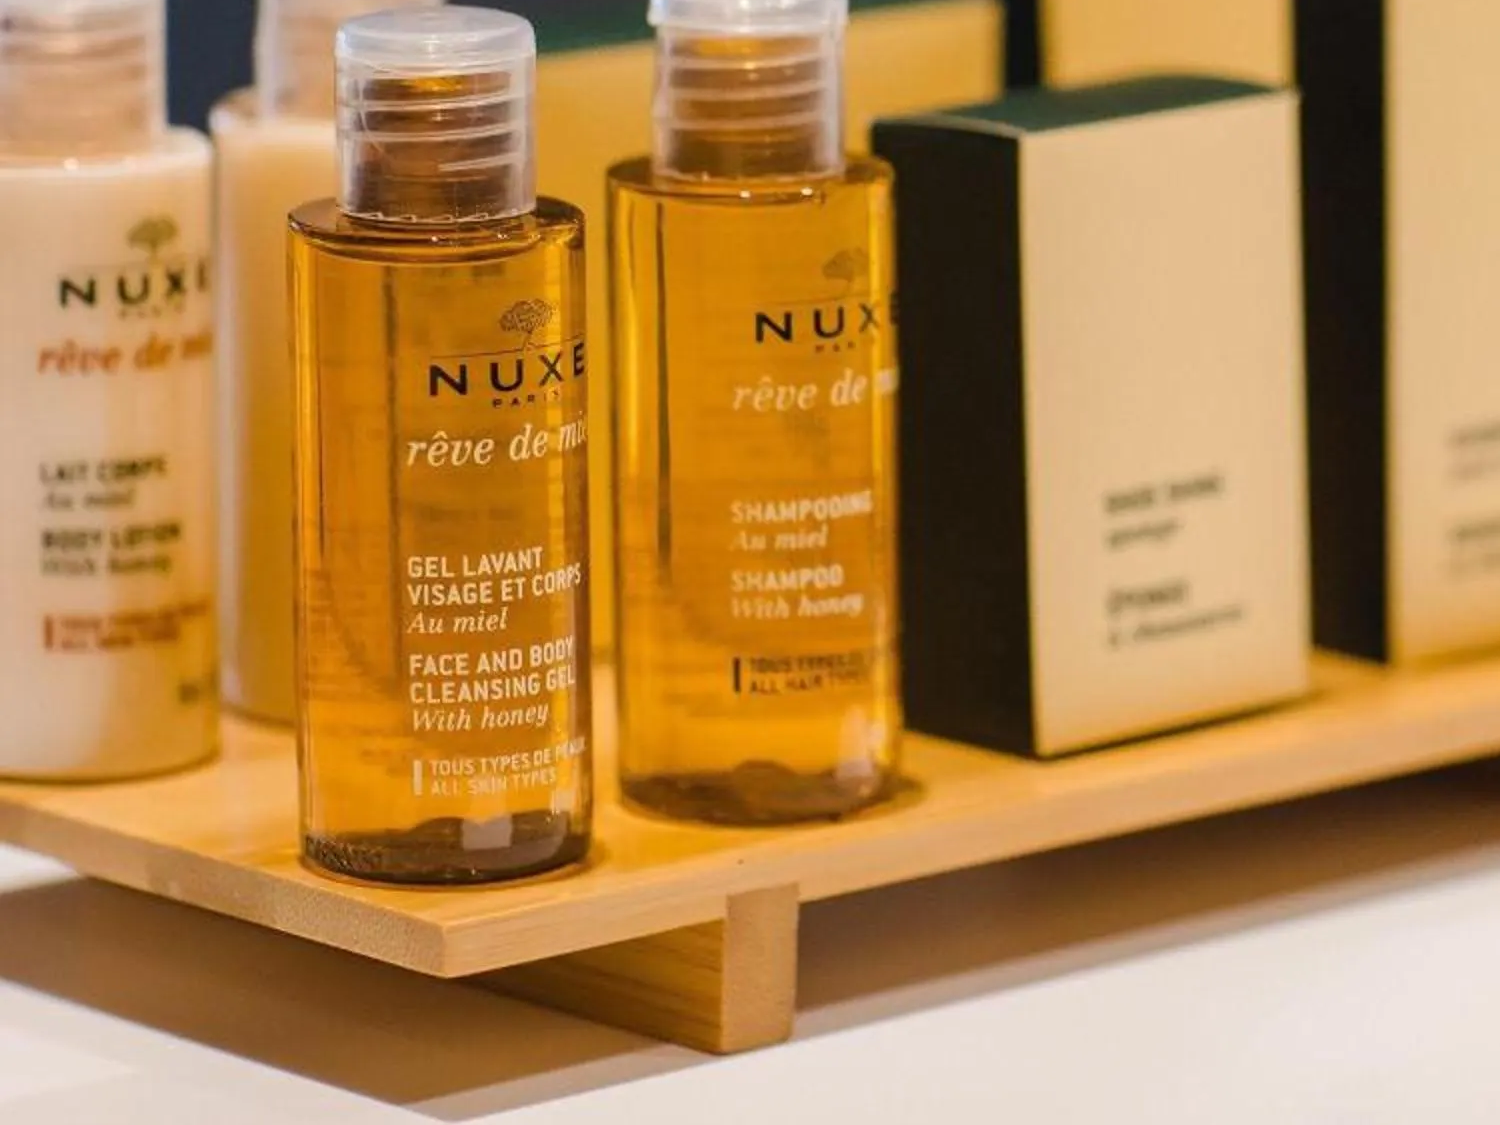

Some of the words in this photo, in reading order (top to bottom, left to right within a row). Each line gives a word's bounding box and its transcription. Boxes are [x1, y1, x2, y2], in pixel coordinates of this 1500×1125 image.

[732, 374, 817, 412] rêve
[831, 367, 868, 407] de
[406, 430, 495, 467] rêve
[509, 422, 549, 461] de
[775, 523, 828, 550] miel
[407, 555, 454, 578] GEL
[463, 546, 543, 576] LAVANT
[731, 563, 844, 592] SHAMPOO
[407, 580, 493, 606] VISAGE
[501, 576, 526, 602] ET
[531, 562, 581, 597] CORPS
[406, 611, 443, 634] Au
[453, 606, 509, 633] miel
[409, 653, 469, 676] FACE
[476, 648, 523, 674] AND
[529, 635, 575, 668] BODY
[409, 672, 541, 704] CLEANSING
[546, 664, 576, 691] GEL
[412, 708, 472, 732] With
[480, 703, 549, 730] honey
[430, 759, 475, 777] TOUS
[480, 752, 530, 774] TYPES
[533, 747, 551, 768] DE
